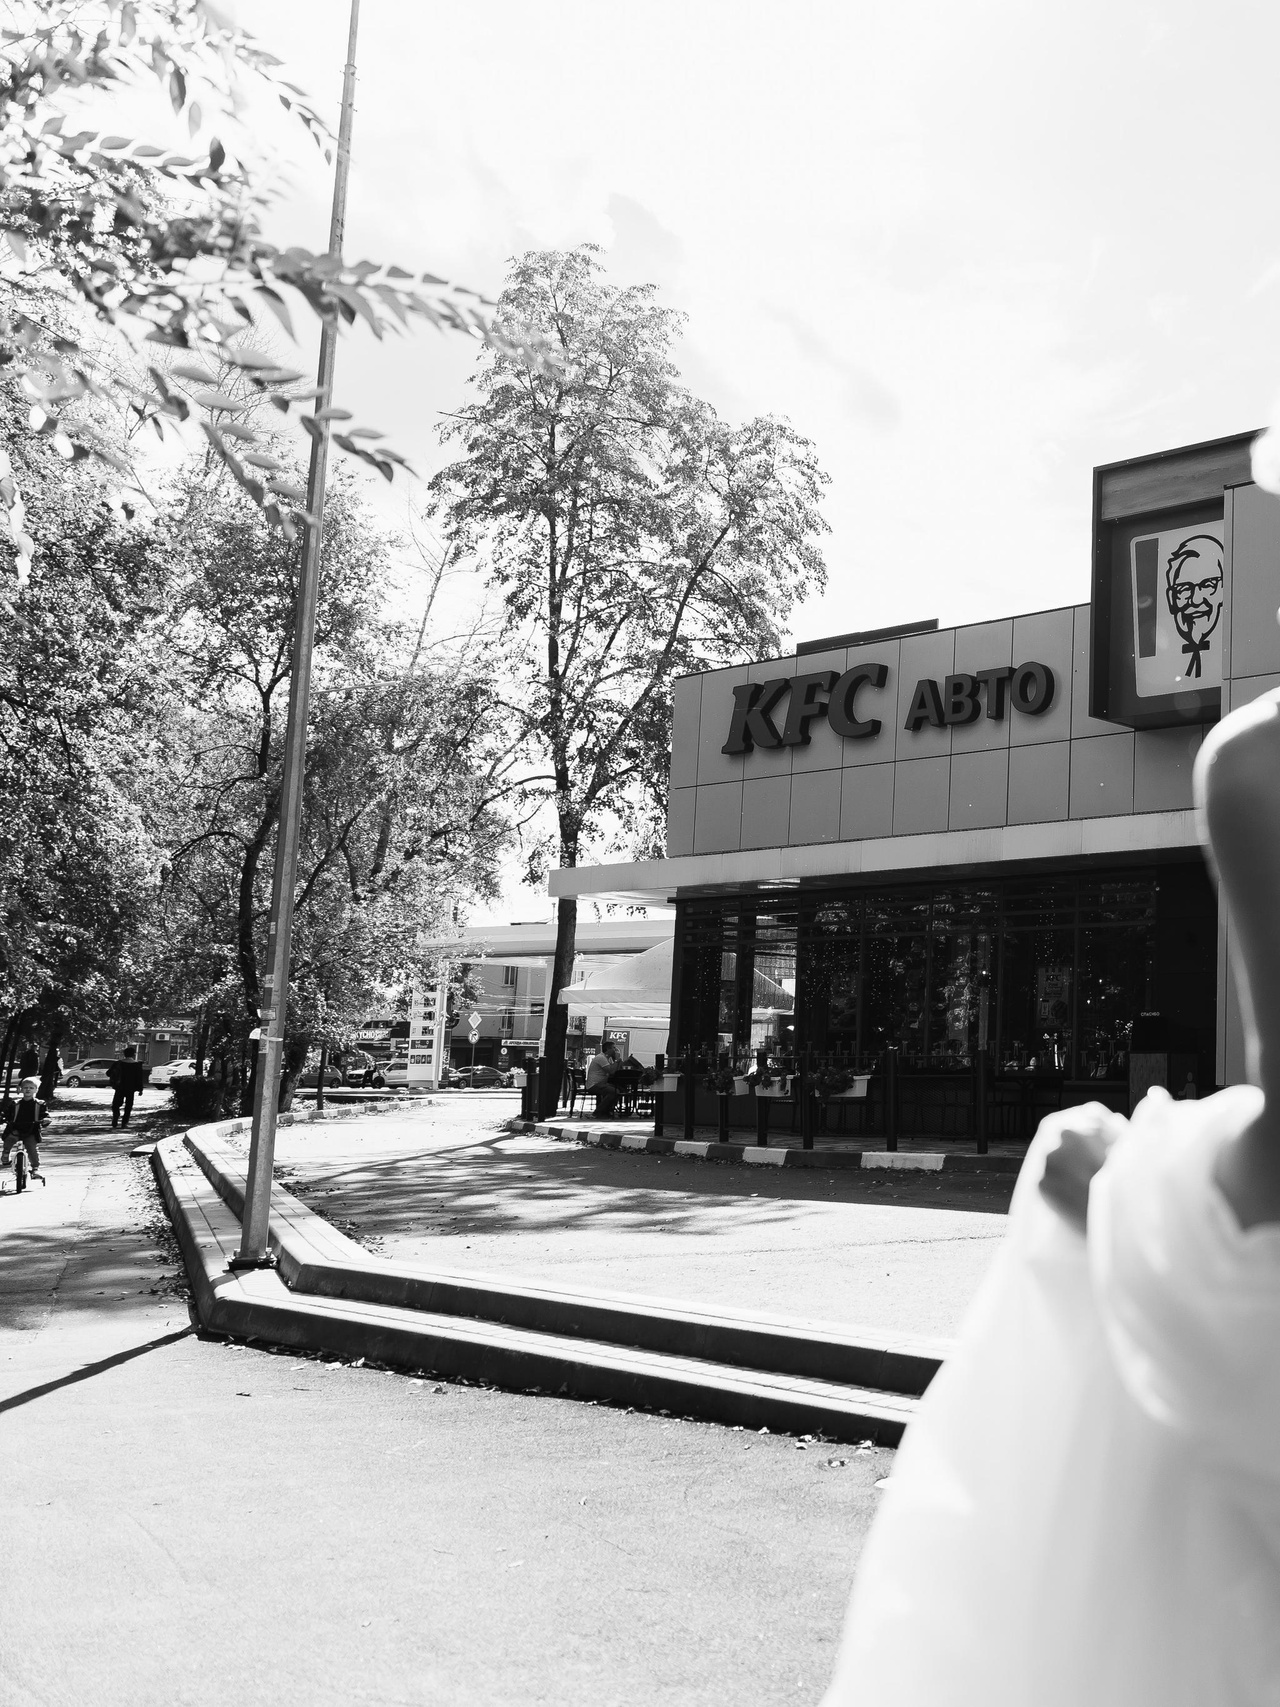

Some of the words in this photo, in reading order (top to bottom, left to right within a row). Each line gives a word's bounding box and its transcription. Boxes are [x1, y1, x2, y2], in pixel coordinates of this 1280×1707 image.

[721, 663, 888, 756] KFC
[904, 661, 1055, 731] АВТО
[609, 1031, 627, 1039] KFC
